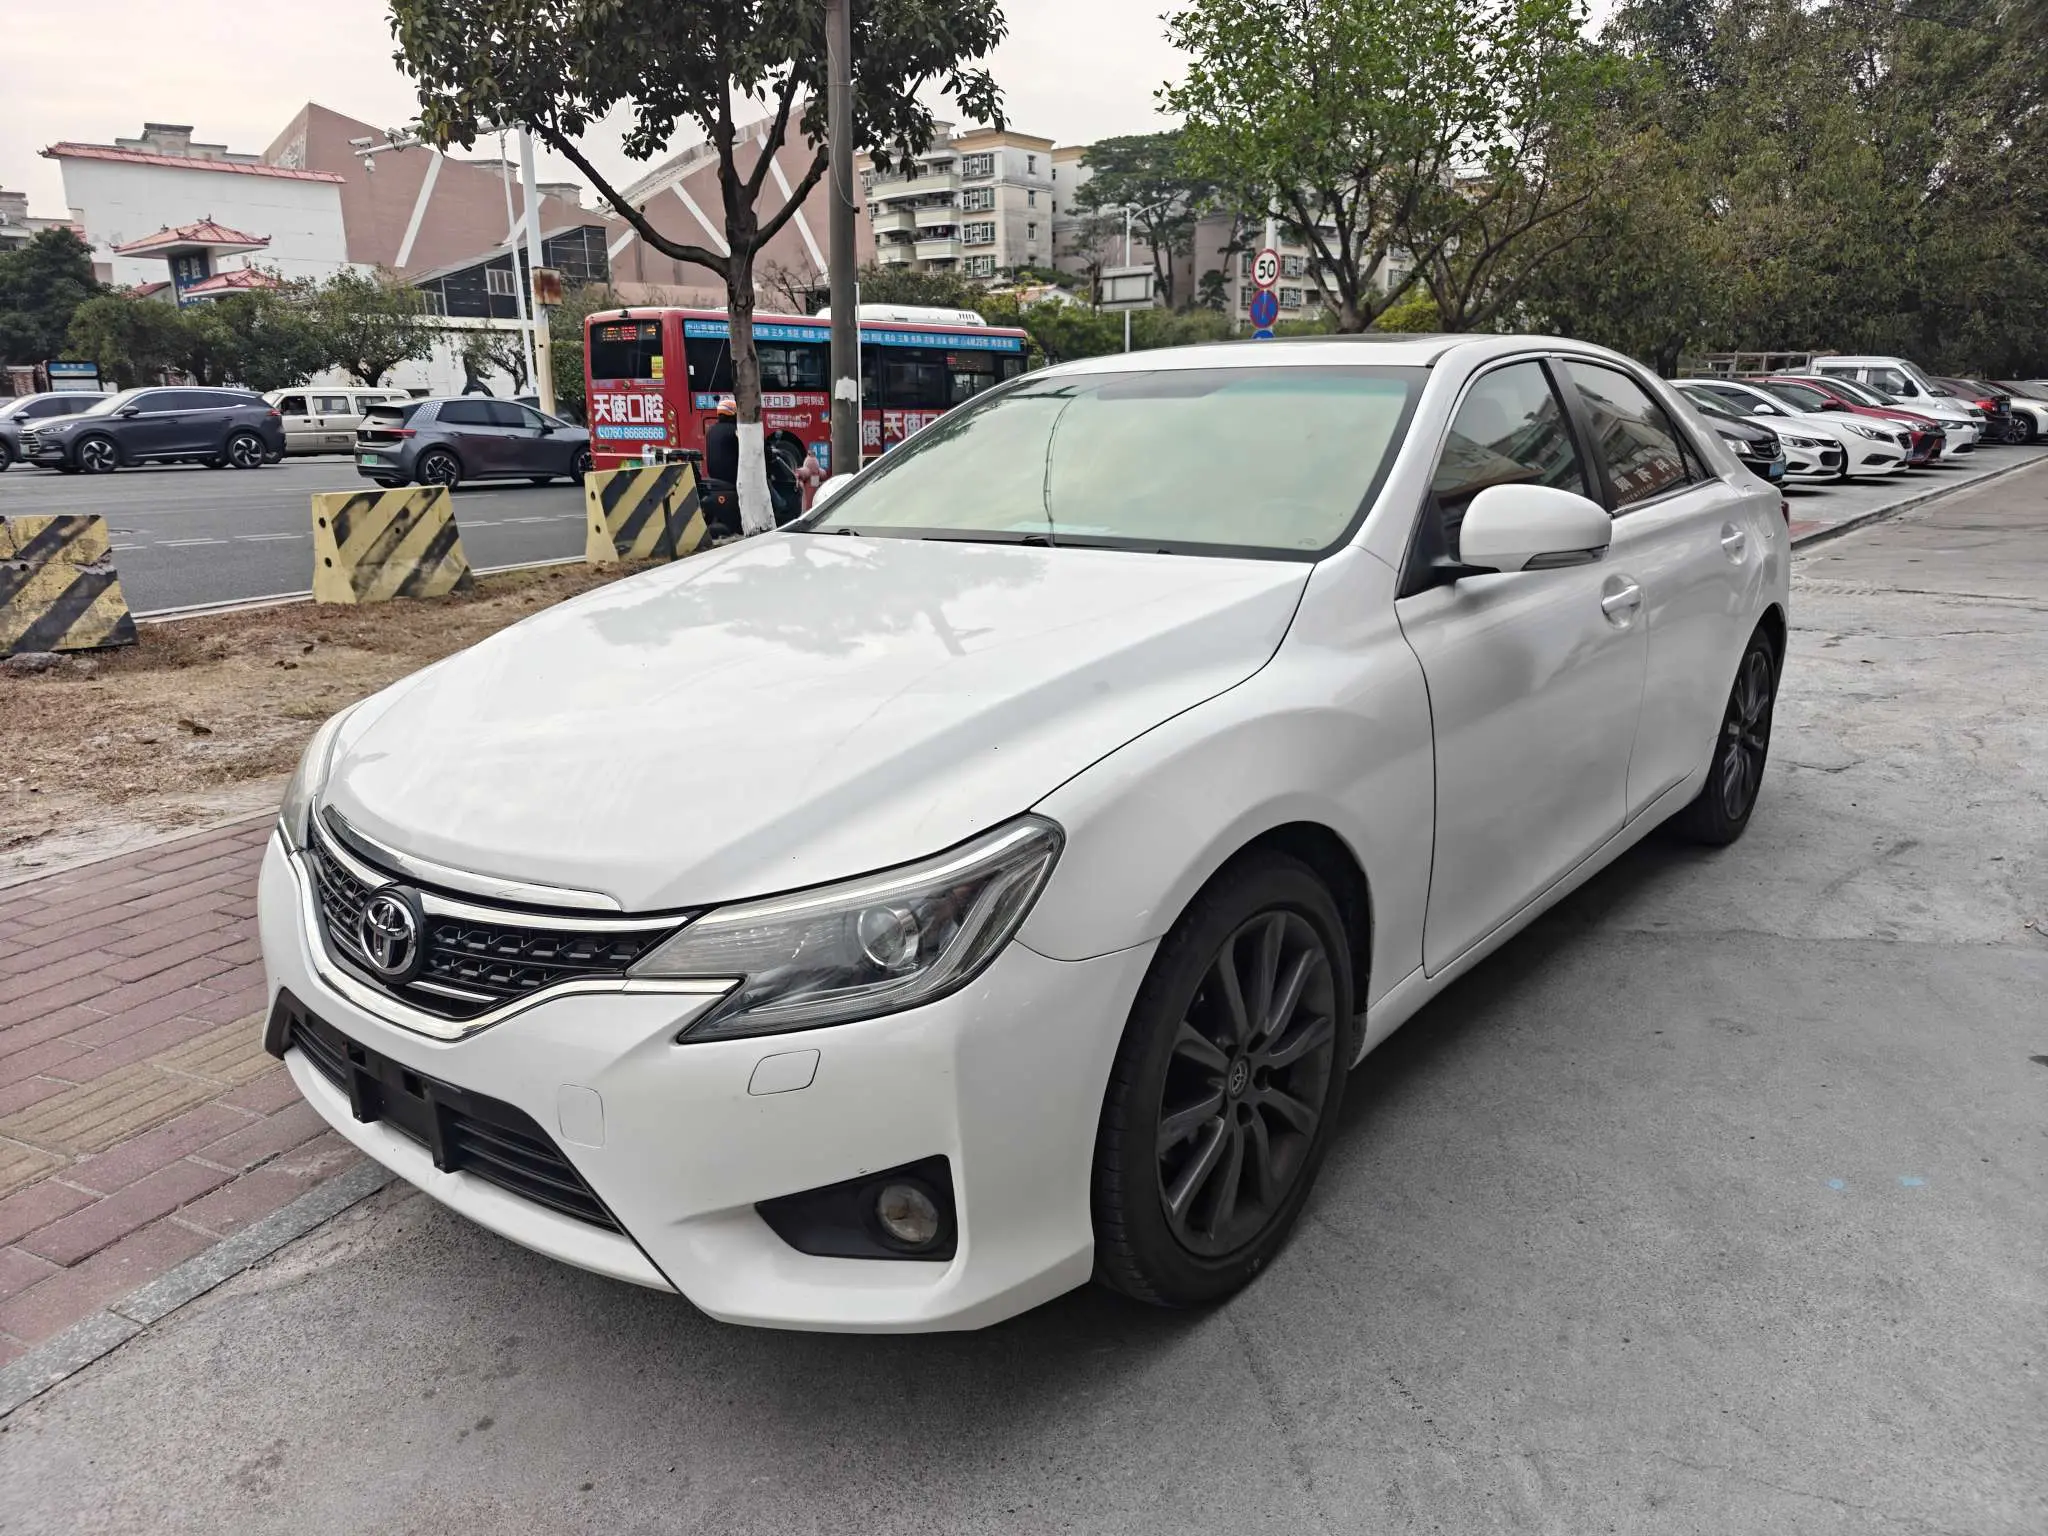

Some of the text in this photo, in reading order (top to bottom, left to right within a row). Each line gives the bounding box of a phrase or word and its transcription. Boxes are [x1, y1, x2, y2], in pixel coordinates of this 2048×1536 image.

[1258, 260, 1276, 279] 50
[593, 393, 665, 423] 天使口腔
